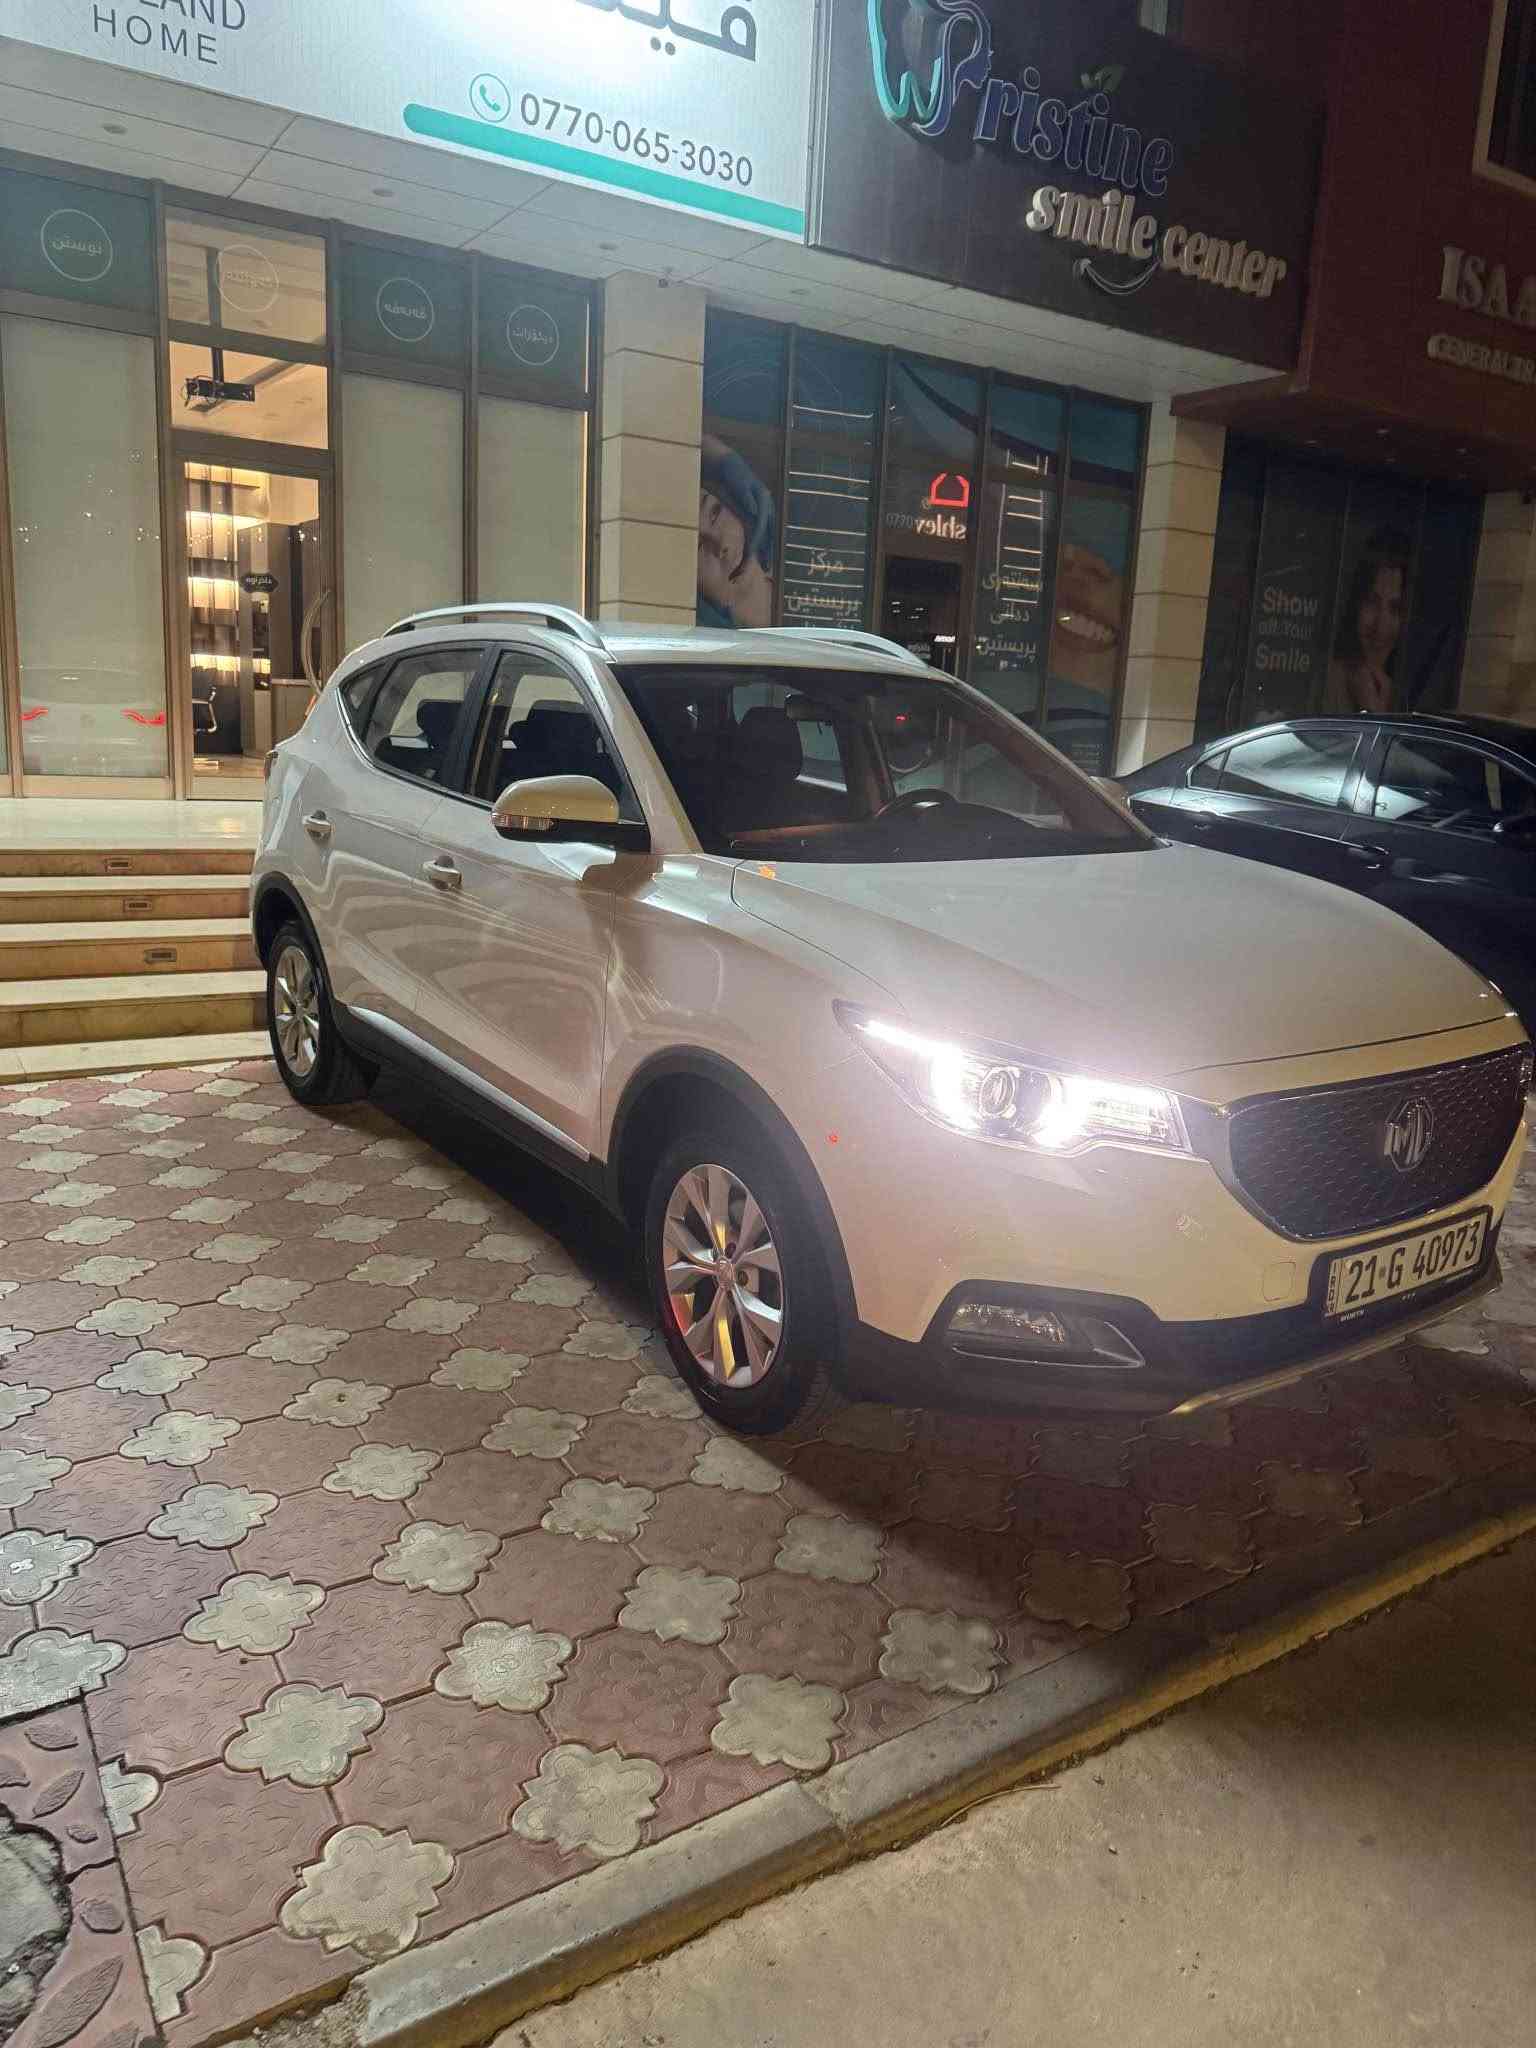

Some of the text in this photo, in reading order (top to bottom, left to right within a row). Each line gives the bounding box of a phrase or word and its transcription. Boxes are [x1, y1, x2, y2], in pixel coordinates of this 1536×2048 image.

[93, 4, 218, 64] HOME
[140, 0, 246, 30] ND
[520, 92, 753, 187] 0770-065-3030
[1025, 185, 1287, 298] smile center
[1263, 586, 1319, 617] Show
[1255, 642, 1310, 673] Smile
[1345, 1220, 1481, 1304] 21 G 40973
